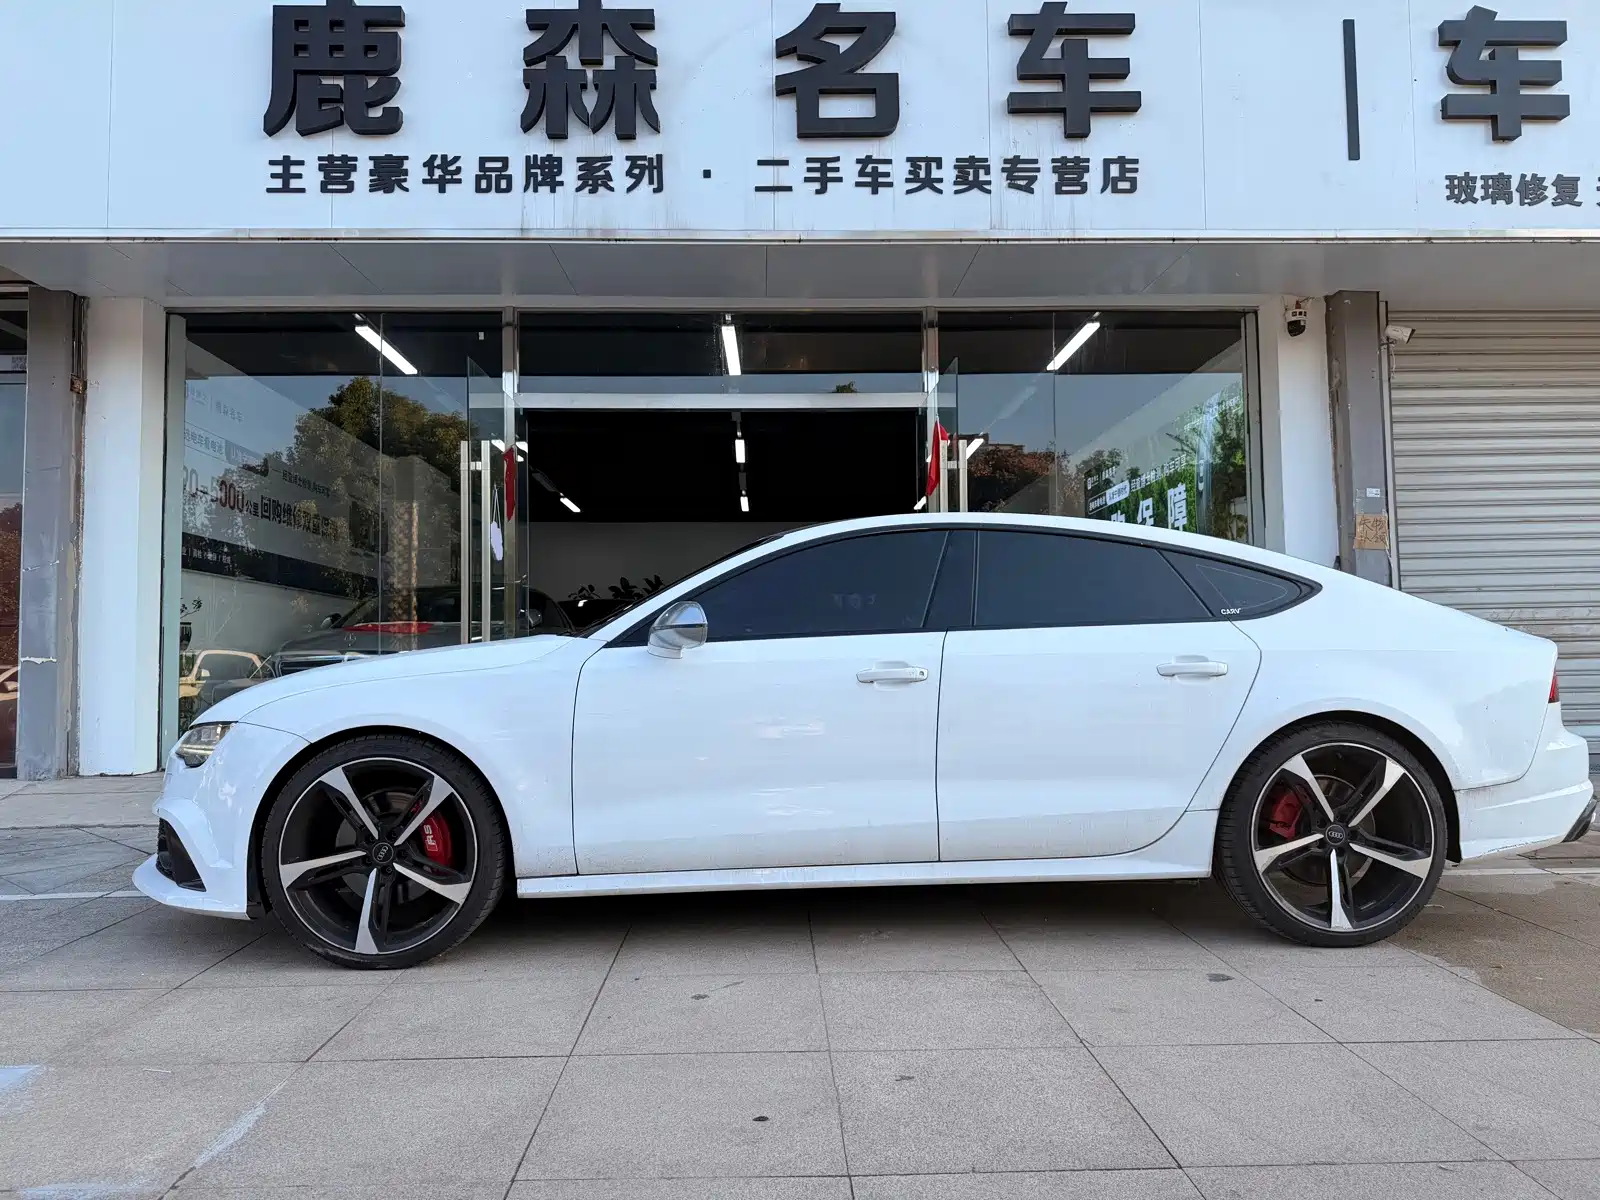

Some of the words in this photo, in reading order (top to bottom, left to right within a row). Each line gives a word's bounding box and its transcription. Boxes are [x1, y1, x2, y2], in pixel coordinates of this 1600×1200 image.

[264, 0, 1141, 139] 鹿森名车
[1438, 5, 1570, 142] 车
[1445, 172, 1582, 207] 玻璃修复
